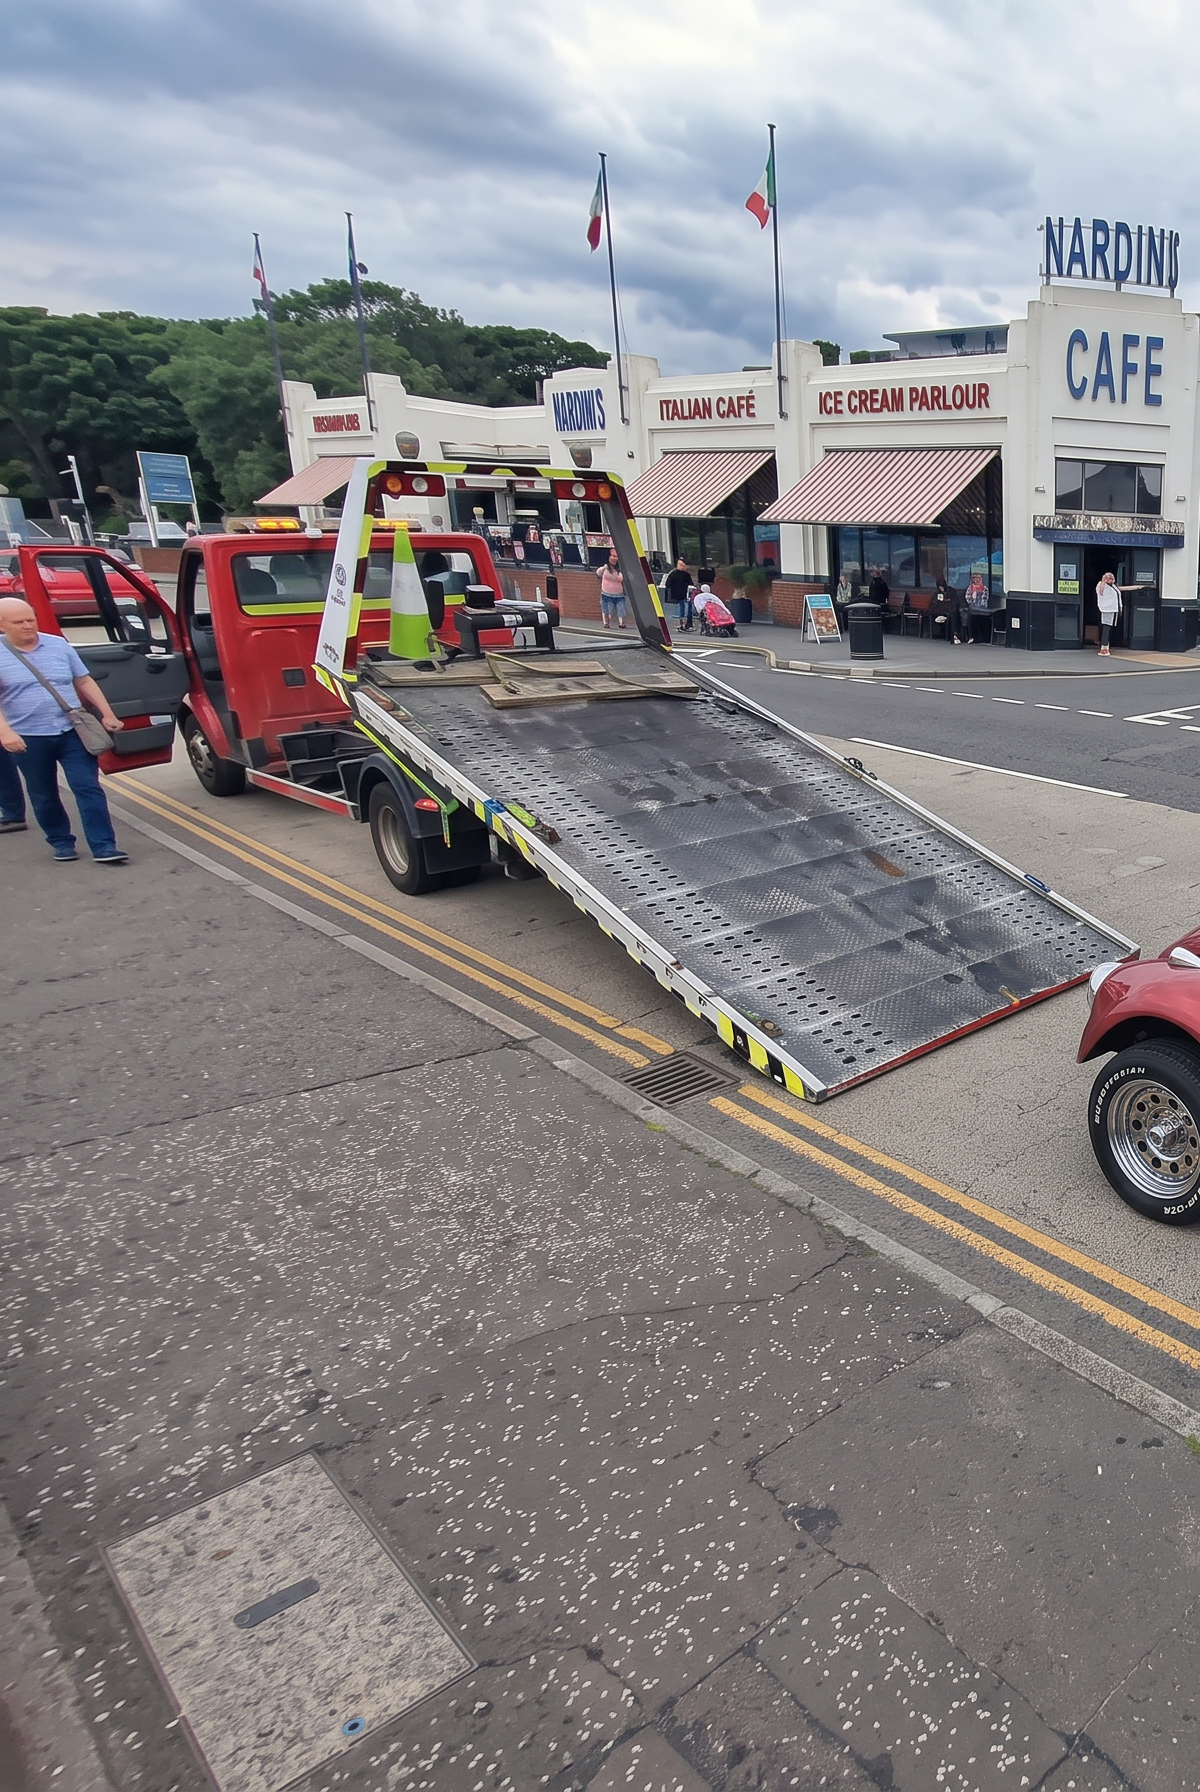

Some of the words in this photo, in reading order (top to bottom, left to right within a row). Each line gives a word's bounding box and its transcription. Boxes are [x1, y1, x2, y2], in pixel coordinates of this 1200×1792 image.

[1066, 328, 1164, 406] CAFE
[659, 396, 713, 421] ITALIAN
[818, 390, 844, 415] ICE
[847, 386, 905, 414] CREAM
[908, 382, 990, 412] PARLOUR
